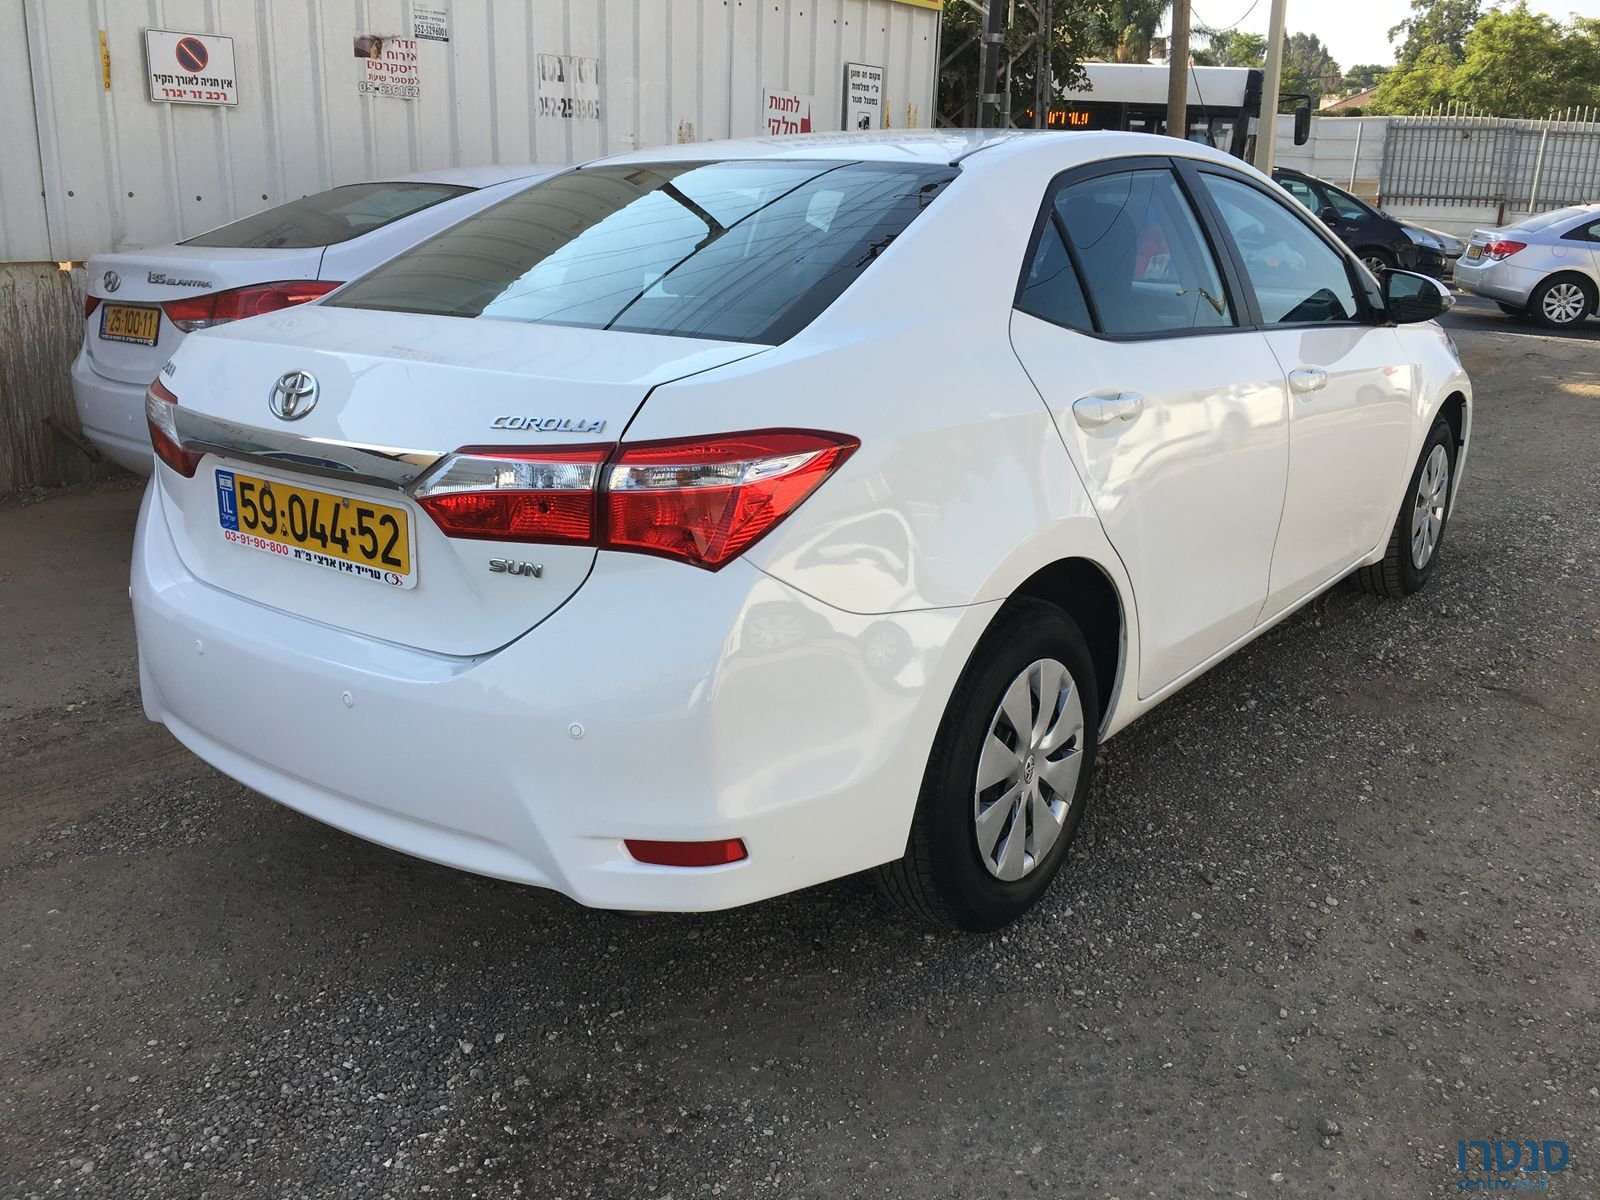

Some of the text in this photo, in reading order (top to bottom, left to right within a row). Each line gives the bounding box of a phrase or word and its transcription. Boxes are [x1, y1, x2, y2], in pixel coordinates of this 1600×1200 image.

[391, 39, 417, 49] חדרי
[386, 50, 417, 61] אירוח
[153, 73, 233, 90] אין חניה לאורך הקיר
[869, 72, 881, 81] מקום
[162, 88, 228, 101] רכב זר יגרר
[769, 95, 800, 113] לחנות
[768, 115, 799, 136] חלקי
[166, 278, 213, 289] ELANTRA
[489, 415, 607, 434] COROLLA
[224, 530, 289, 556] 03-91-90-800
[314, 555, 337, 568] ארצי
[338, 560, 353, 573] אין
[489, 558, 544, 579] SUN
[355, 565, 381, 580] טרייד
